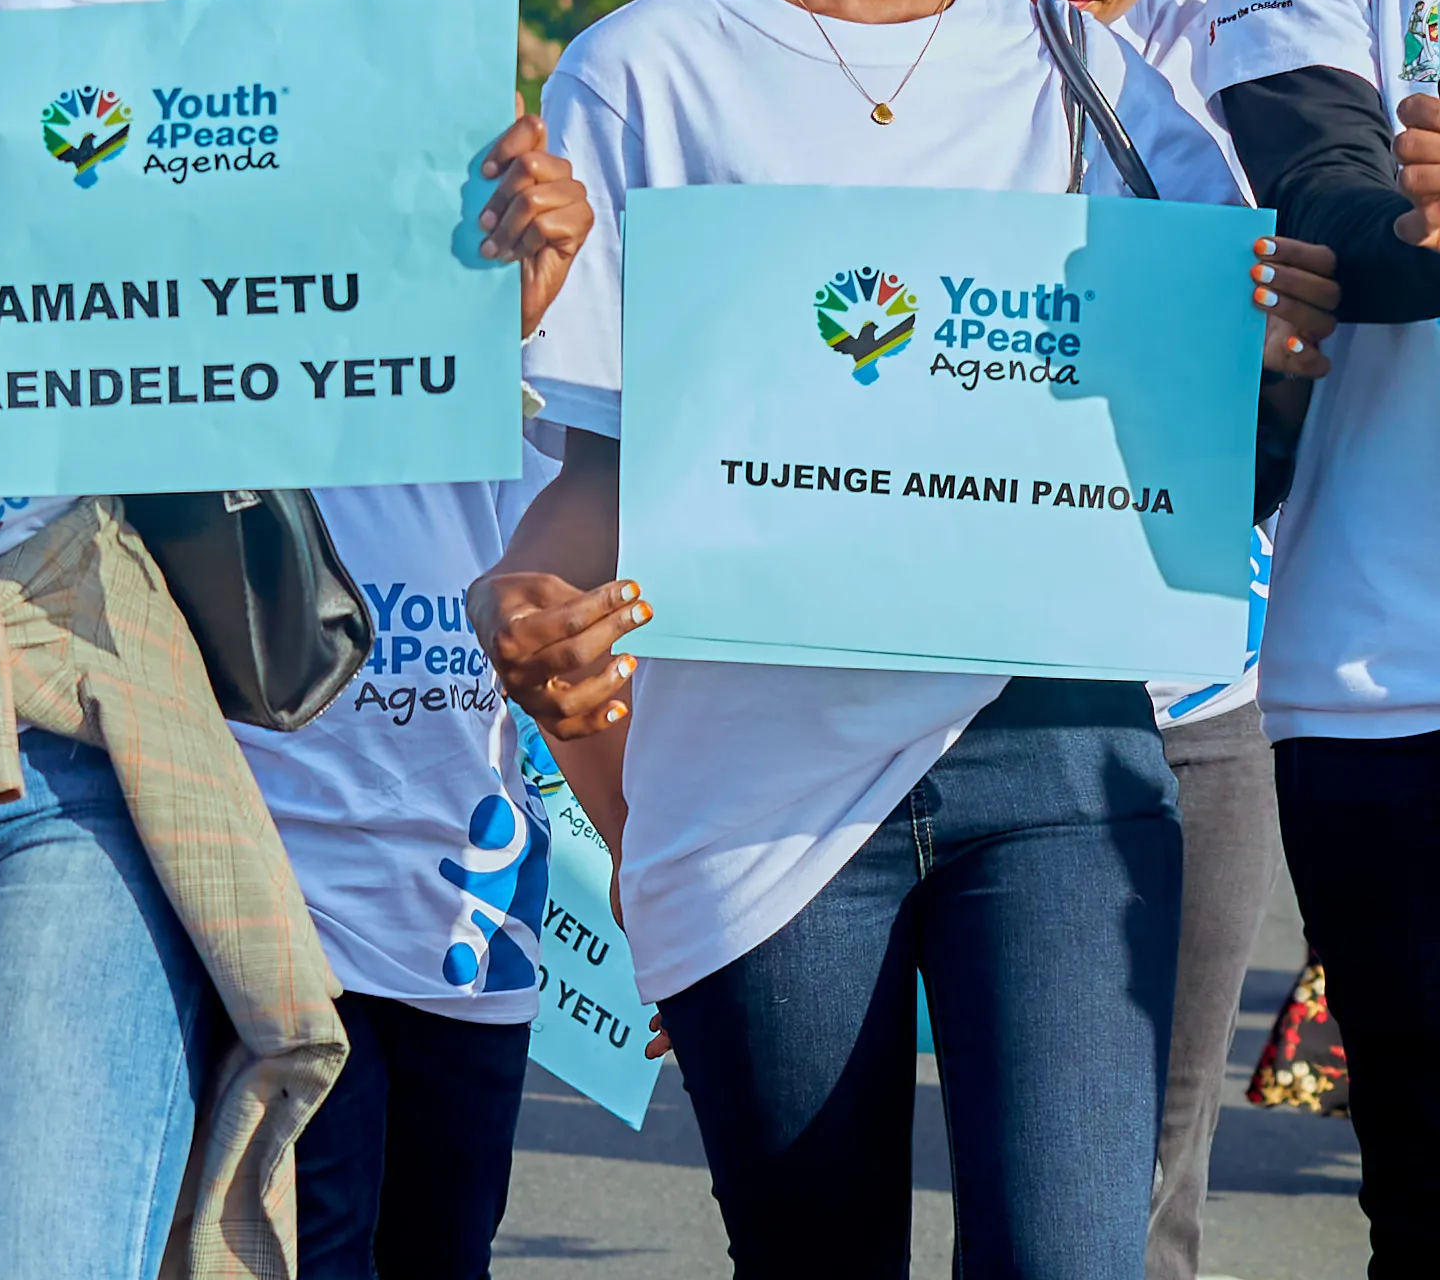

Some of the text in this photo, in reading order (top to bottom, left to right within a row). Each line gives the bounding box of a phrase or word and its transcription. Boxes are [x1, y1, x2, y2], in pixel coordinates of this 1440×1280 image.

[1251, 0, 1293, 11] Children
[151, 82, 278, 120] Youth
[146, 122, 280, 150] 4Peace
[142, 147, 281, 186] Agenda
[201, 272, 360, 316] YETU
[939, 275, 1082, 323] Youth
[934, 319, 1082, 357] 4Peace
[299, 355, 457, 399] YETU
[929, 352, 1081, 391] Agenda
[720, 459, 1175, 516] TUJENGE AMANI PAMOJA
[362, 583, 475, 634] You
[365, 636, 489, 676] 4Peac
[354, 679, 496, 726] Agenda
[543, 898, 610, 967] YETU
[557, 979, 631, 1049] YETU
